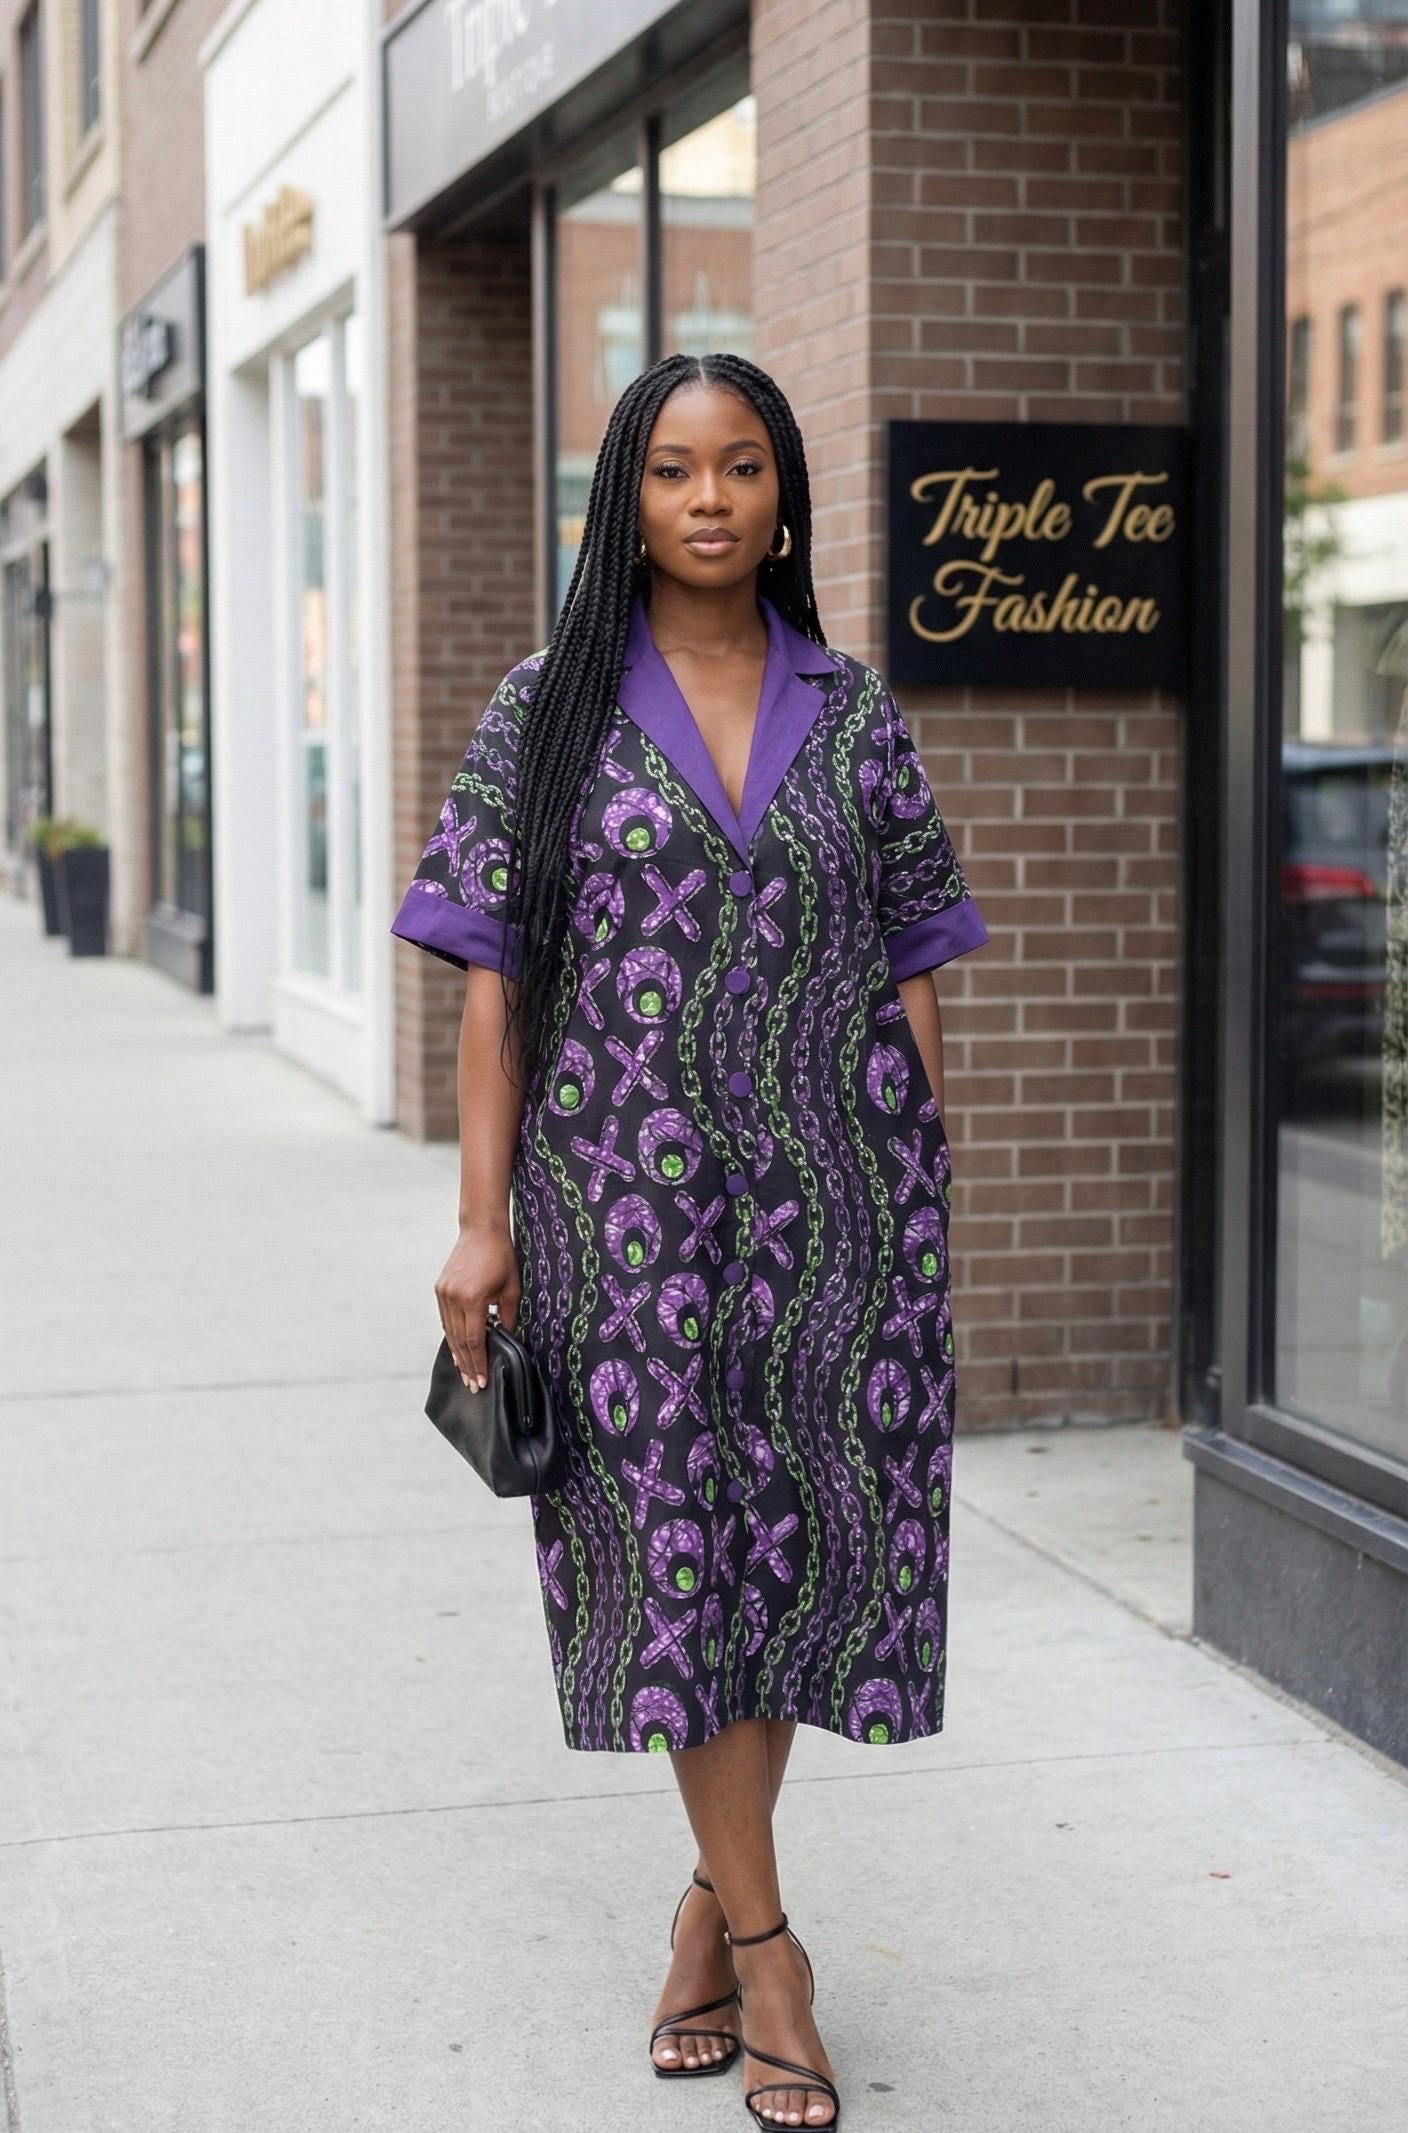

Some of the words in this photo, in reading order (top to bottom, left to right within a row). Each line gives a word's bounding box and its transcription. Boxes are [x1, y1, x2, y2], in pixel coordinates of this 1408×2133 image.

[910, 467, 1072, 562] Triple
[1082, 471, 1175, 548] Tee
[910, 560, 1160, 643] Fashion
